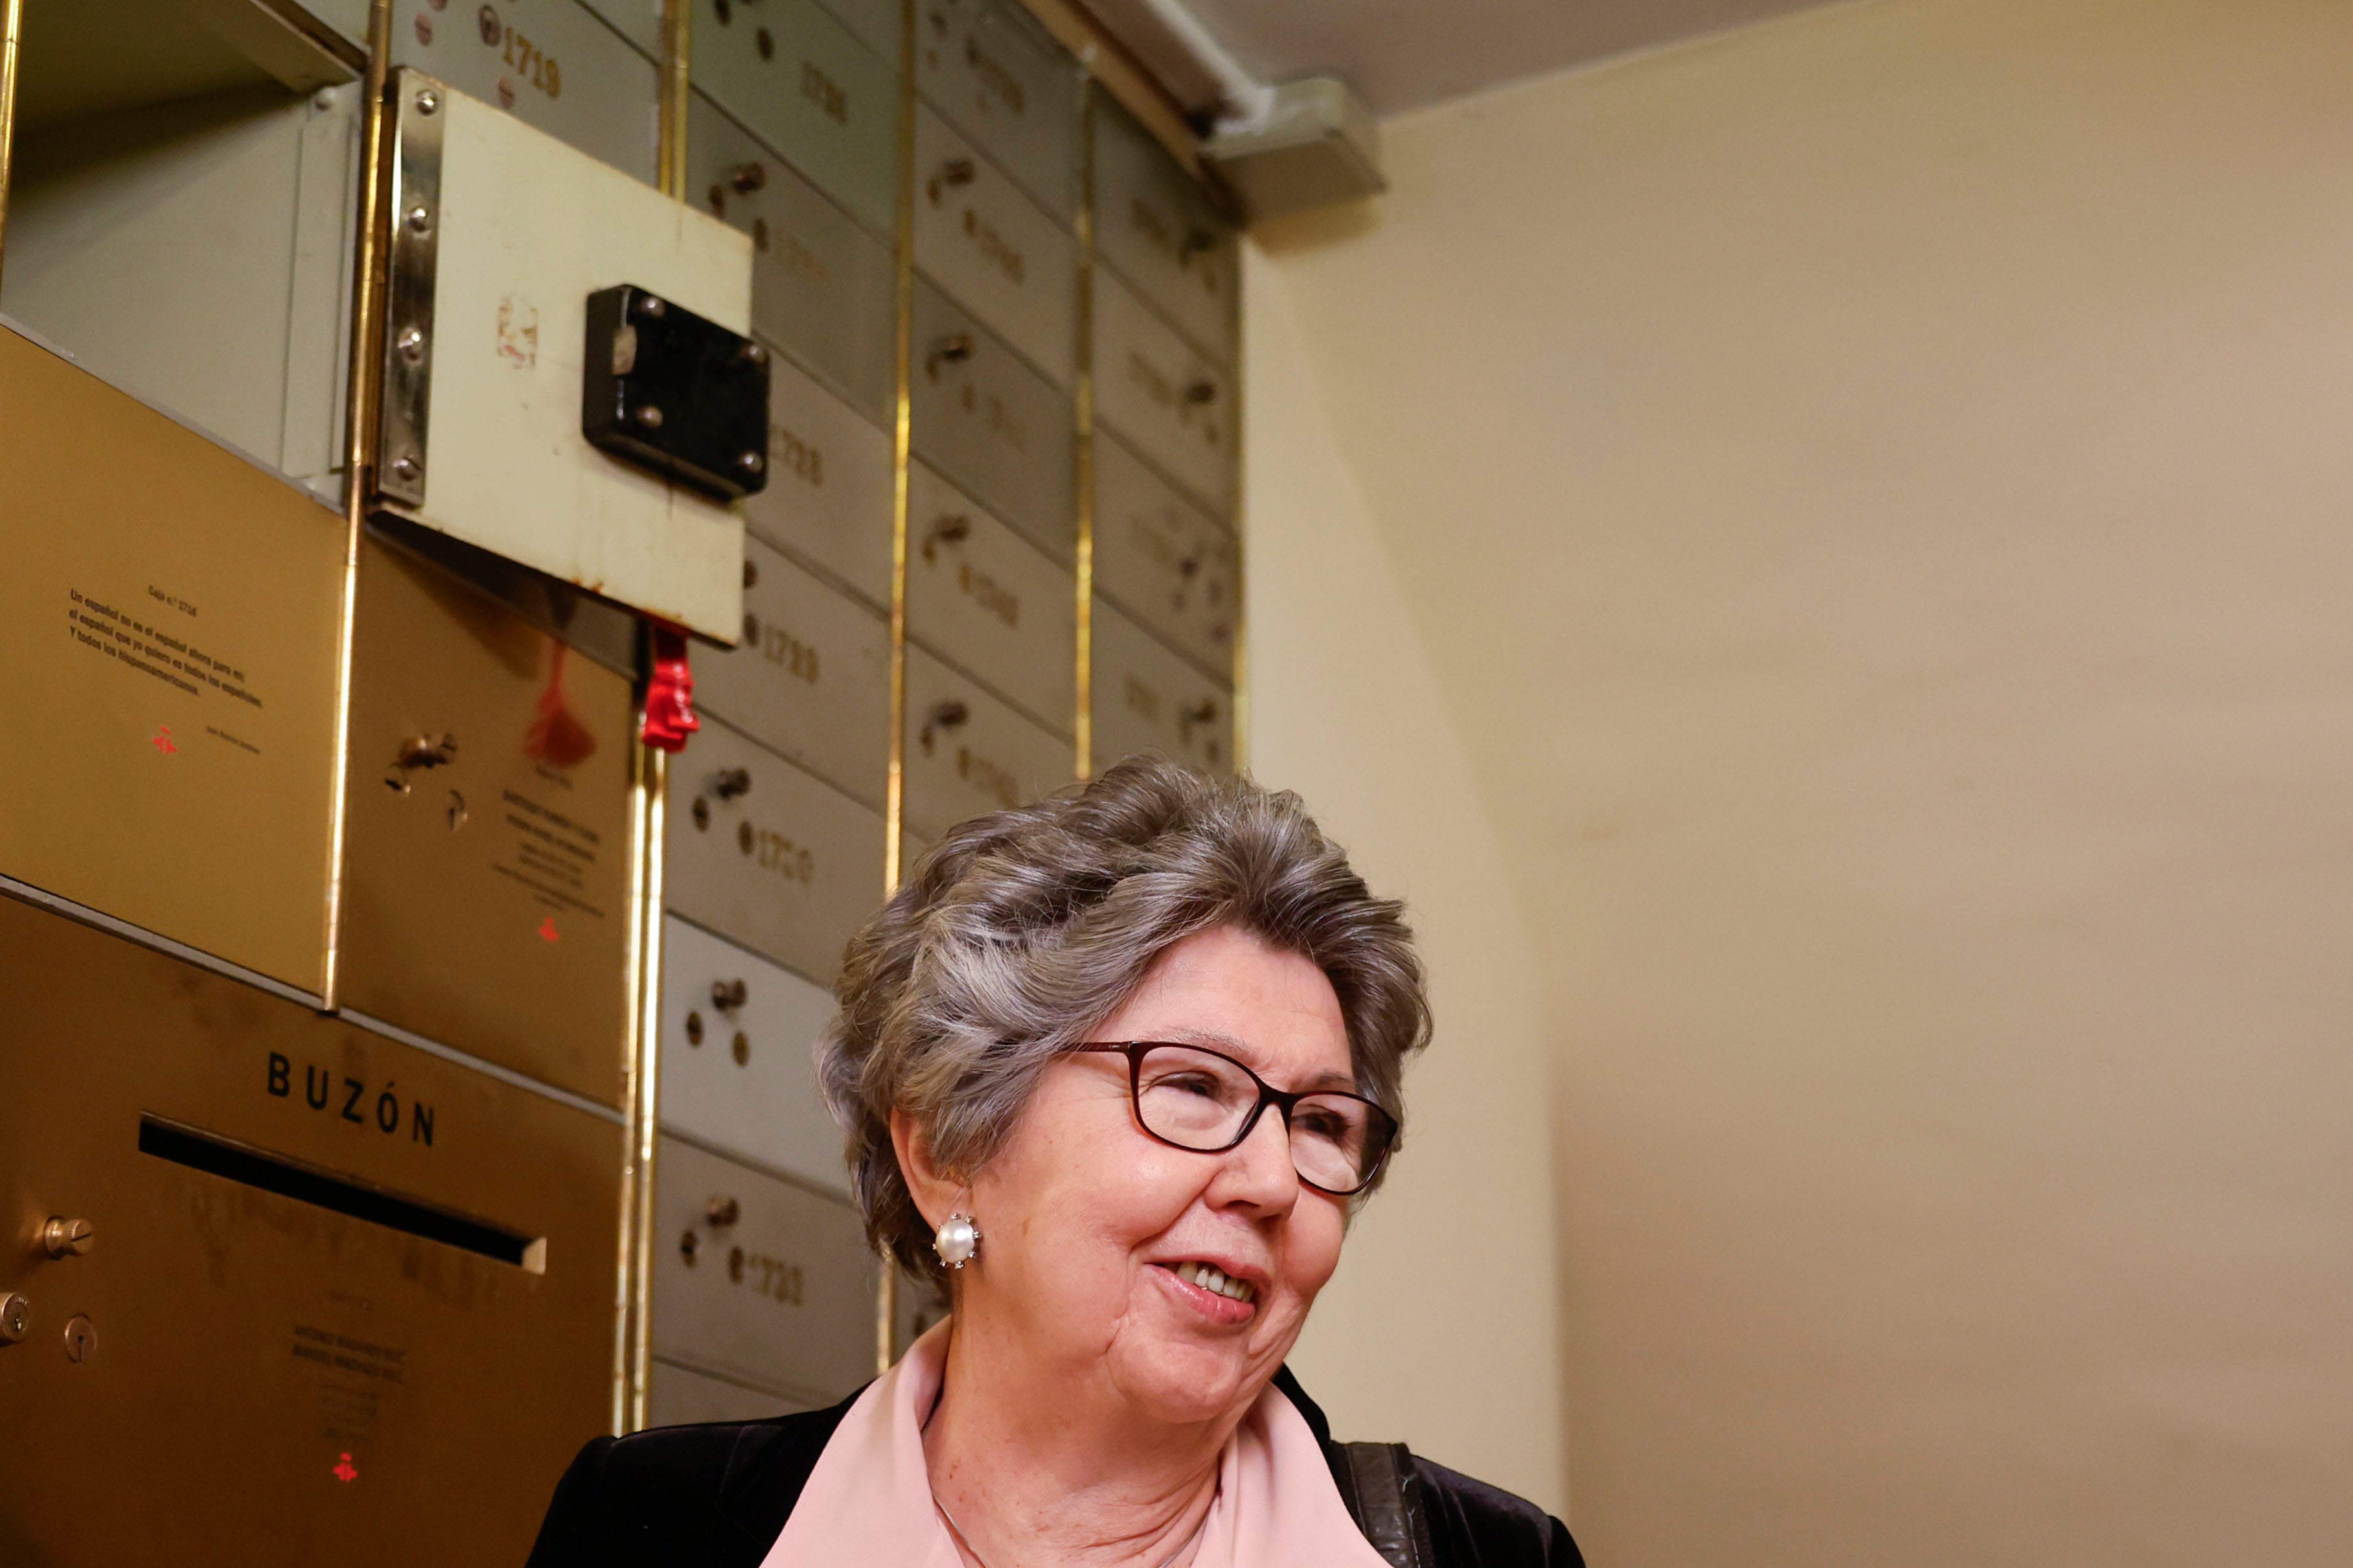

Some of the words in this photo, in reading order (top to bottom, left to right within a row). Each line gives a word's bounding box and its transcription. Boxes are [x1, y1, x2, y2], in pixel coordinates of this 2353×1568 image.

[501, 27, 560, 99] 1719
[70, 588, 82, 603] Un
[85, 598, 119, 620] español
[80, 615, 114, 636] español
[268, 1051, 434, 1147] BUZÓN
